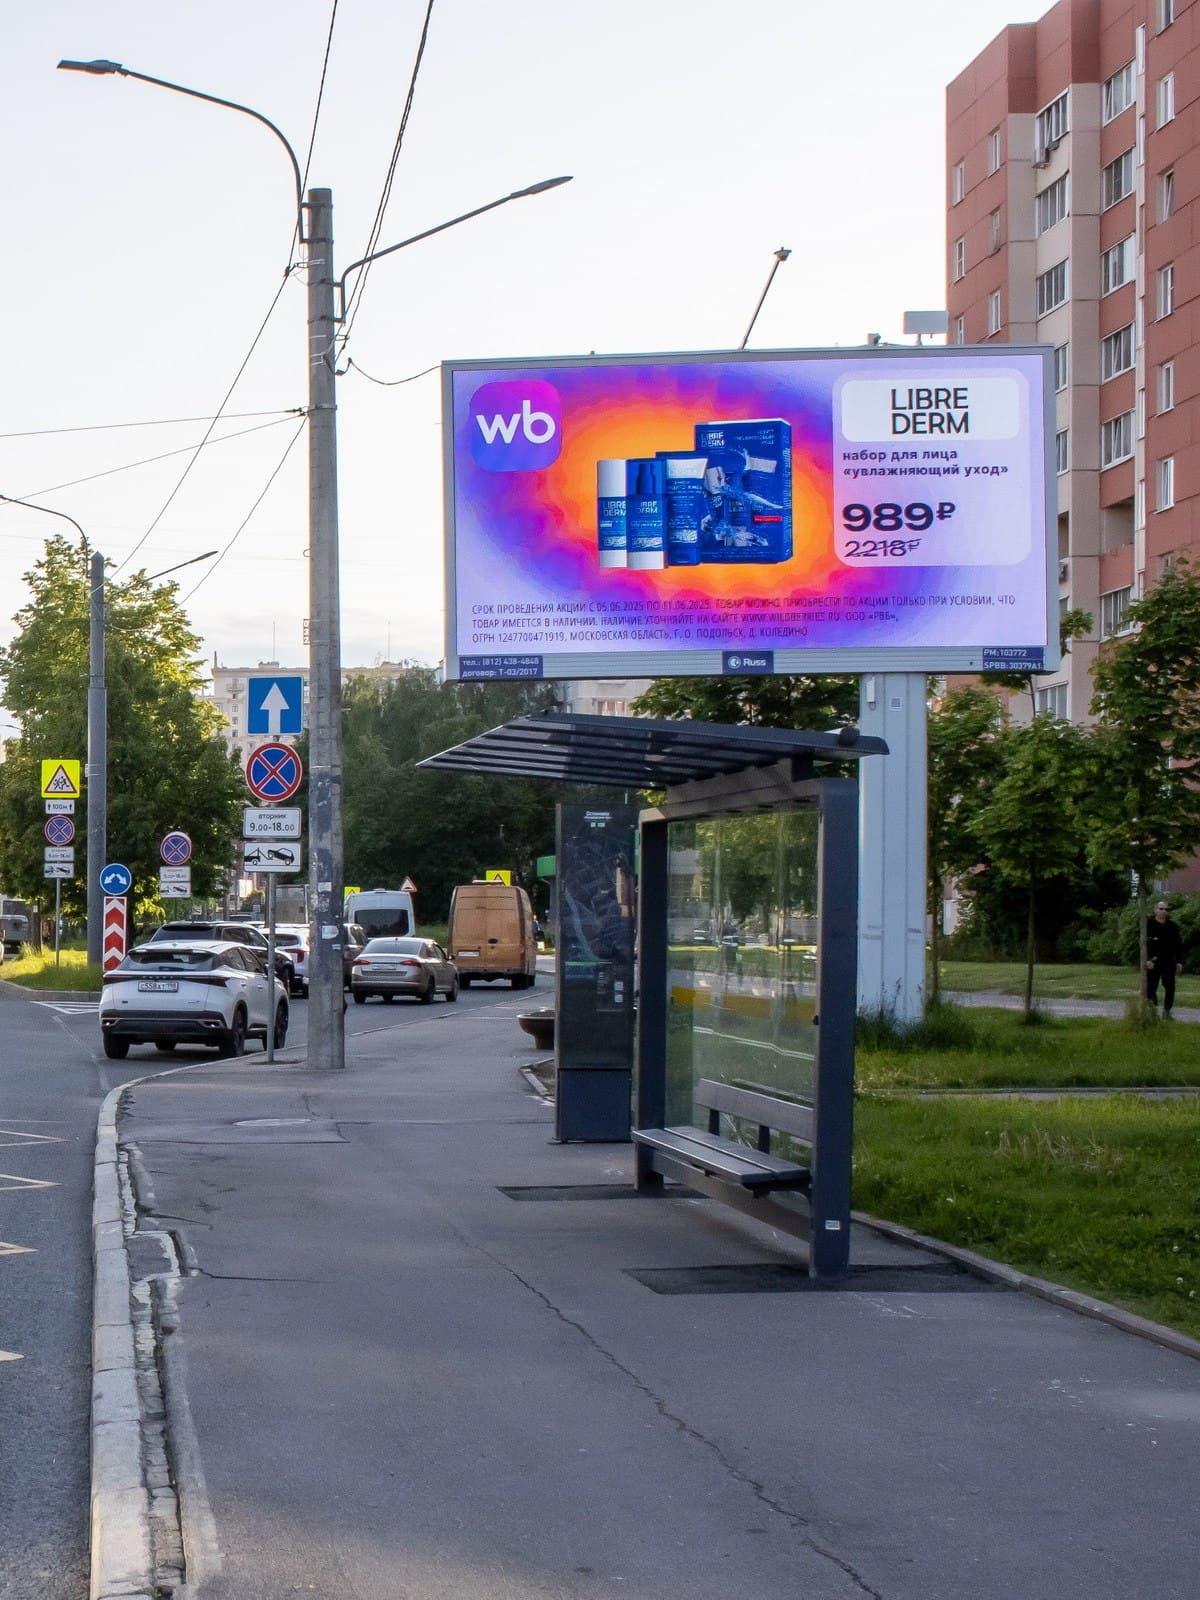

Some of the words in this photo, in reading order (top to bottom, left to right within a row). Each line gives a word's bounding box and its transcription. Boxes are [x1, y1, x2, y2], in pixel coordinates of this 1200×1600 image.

[890, 387, 969, 411] LIBRE
[476, 399, 556, 444] wb
[891, 411, 969, 435] DERM
[843, 450, 886, 463] набор
[891, 451, 918, 462] для
[922, 450, 958, 461] лица
[843, 464, 960, 479] «увлажняющий
[964, 464, 1008, 478] уход»
[472, 604, 494, 615] СРОК
[497, 602, 554, 614] ПРОВЕДЕНИЯ
[556, 601, 585, 614] АКЦИИ
[892, 595, 926, 606] ТОЛЬКО
[928, 595, 947, 606] ПРИ
[997, 594, 1016, 605] ЧТО
[472, 618, 500, 629] ТОВАР
[502, 617, 542, 628] ИМЕЕТСЯ
[472, 633, 495, 643] ОГРН
[570, 630, 628, 641] МОСКОВСКАЯ
[743, 658, 766, 667] Russ
[249, 822, 295, 831] 9.00-18.00
